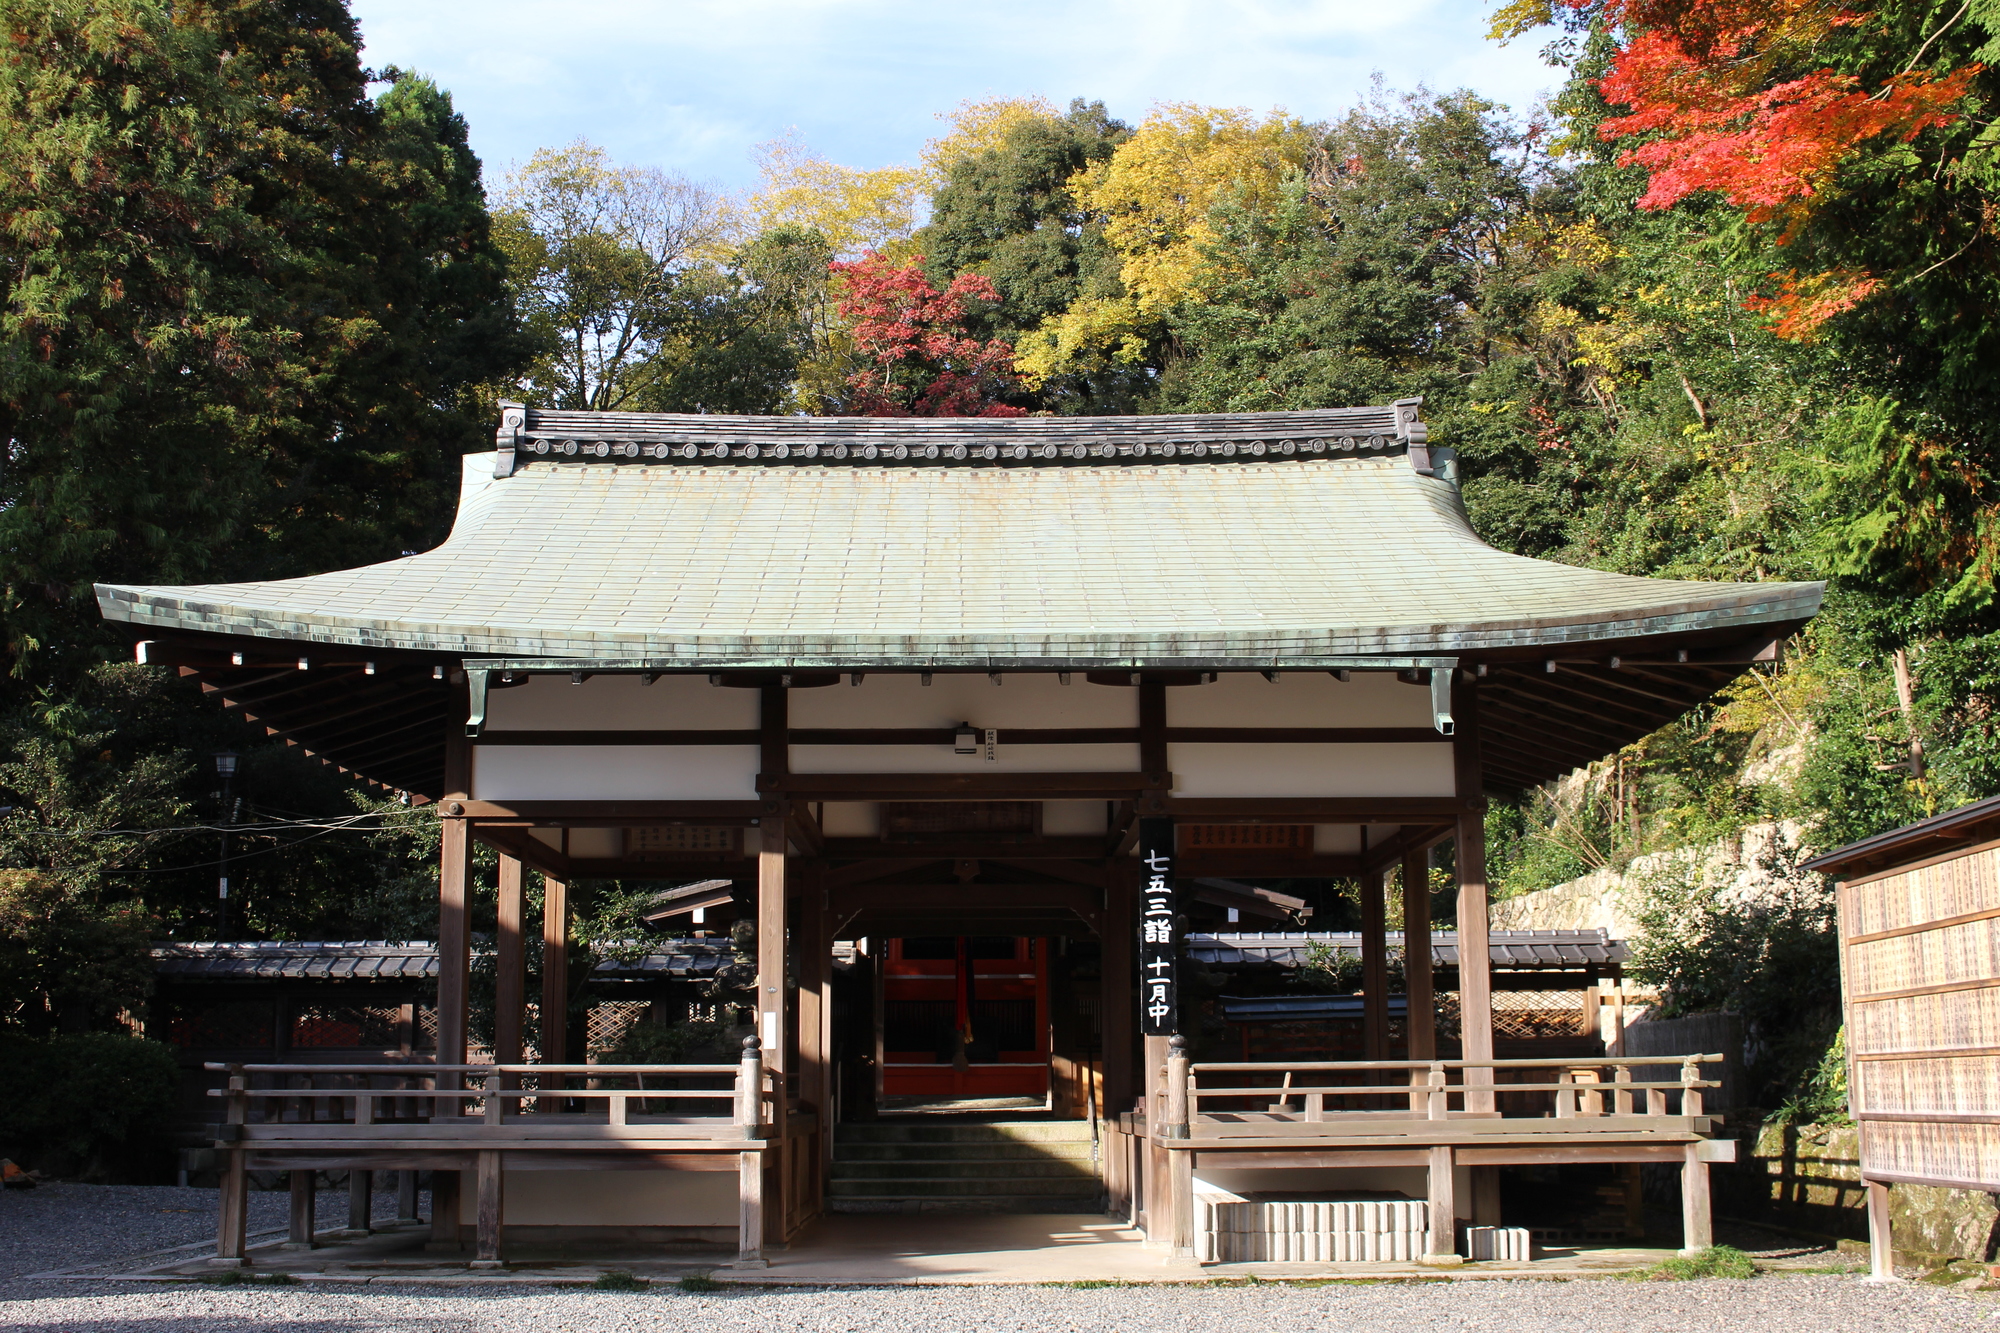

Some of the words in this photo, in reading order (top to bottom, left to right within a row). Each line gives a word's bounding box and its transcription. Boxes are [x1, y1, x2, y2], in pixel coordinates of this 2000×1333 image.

[1144, 849, 1173, 944] 七五三詣
[1147, 956, 1171, 1028] 十一月中
